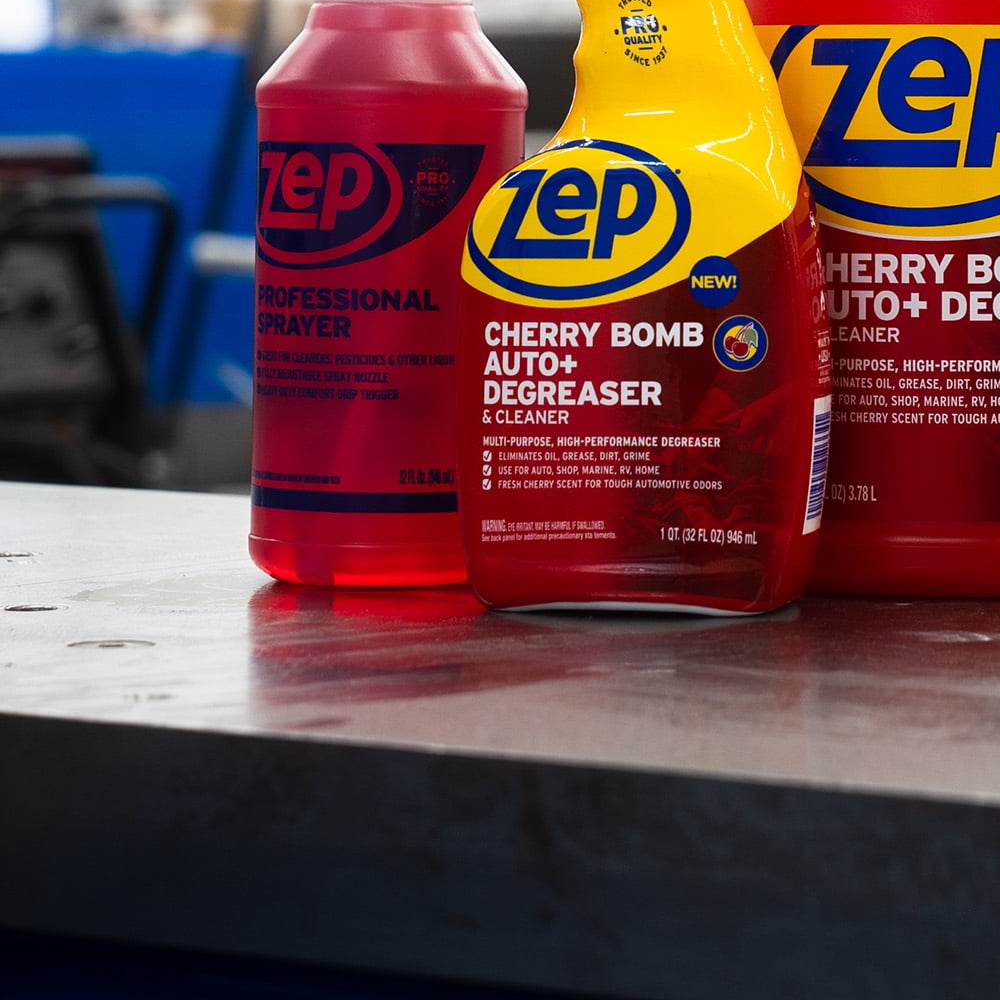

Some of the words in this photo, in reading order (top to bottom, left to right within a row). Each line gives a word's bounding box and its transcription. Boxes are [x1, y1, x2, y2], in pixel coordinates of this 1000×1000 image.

[620, 14, 659, 35] PRO
[624, 34, 662, 45] QUALITY
[624, 48, 650, 67] SINCE
[652, 46, 668, 65] 1937
[416, 171, 449, 184] PRO
[825, 252, 955, 284] HERRY
[691, 276, 737, 289] NEW!
[259, 285, 440, 312] PROFESSIONAL
[826, 289, 927, 321] UTO+
[258, 312, 351, 338] SPRAYER
[485, 321, 601, 347] CHERRY
[611, 321, 704, 347] BOMB
[830, 327, 900, 343] LEANER
[335, 353, 386, 365] PESTICIDES
[388, 354, 395, 365] &
[397, 354, 427, 366] OTHER
[484, 351, 578, 376] AUTO+
[324, 371, 352, 382] SPRAY
[354, 372, 389, 383] NOZZLE
[876, 378, 896, 391] OIL,
[898, 379, 943, 391] GREASE,
[946, 379, 972, 391] DIRT,
[360, 389, 399, 400] TRIGGER
[483, 381, 662, 406] DEGREASER
[838, 394, 856, 406] FOR
[859, 394, 888, 406] AUTO,
[891, 394, 920, 406] SHOP,
[923, 394, 969, 406] MARINE,
[972, 394, 988, 406] RV,
[482, 410, 491, 424] &
[495, 410, 569, 424] CLEANER
[850, 411, 888, 424] CHERRY
[891, 411, 925, 424] SCENT
[928, 411, 949, 424] FOR
[952, 411, 987, 424] TOUGH
[483, 436, 554, 448] MULTI-PURPOSE,
[557, 437, 658, 447] HIGH-PERFORMANCE
[661, 437, 721, 448] DEGREASER
[498, 452, 543, 461] ELIMINATES
[544, 452, 560, 461] OIL,
[562, 452, 597, 461] GREASE,
[600, 452, 620, 461] DIRT,
[623, 452, 650, 461] GRIME
[498, 466, 512, 475] USE
[514, 466, 529, 475] FOR
[531, 466, 554, 475] AUTO,
[556, 466, 579, 475] SHOP,
[582, 466, 617, 475] MARINE,
[620, 466, 633, 475] RV,
[635, 466, 660, 475] HOME
[498, 479, 521, 489] FRESH
[523, 479, 554, 489] CHERRY
[556, 479, 583, 489] SCENT
[585, 479, 601, 489] FOR
[604, 479, 633, 489] TOUGH
[635, 479, 690, 489] AUTOMOTIVE
[693, 479, 722, 489] ODORS
[831, 484, 846, 504] OZ)
[848, 485, 869, 501] 3.78
[871, 485, 877, 501] L
[660, 527, 664, 540] 1
[667, 527, 680, 541] QT.
[682, 528, 696, 544] (32
[698, 528, 708, 542] FL
[711, 529, 725, 545] OZ)
[727, 530, 743, 544] 946
[745, 531, 757, 544] mL
